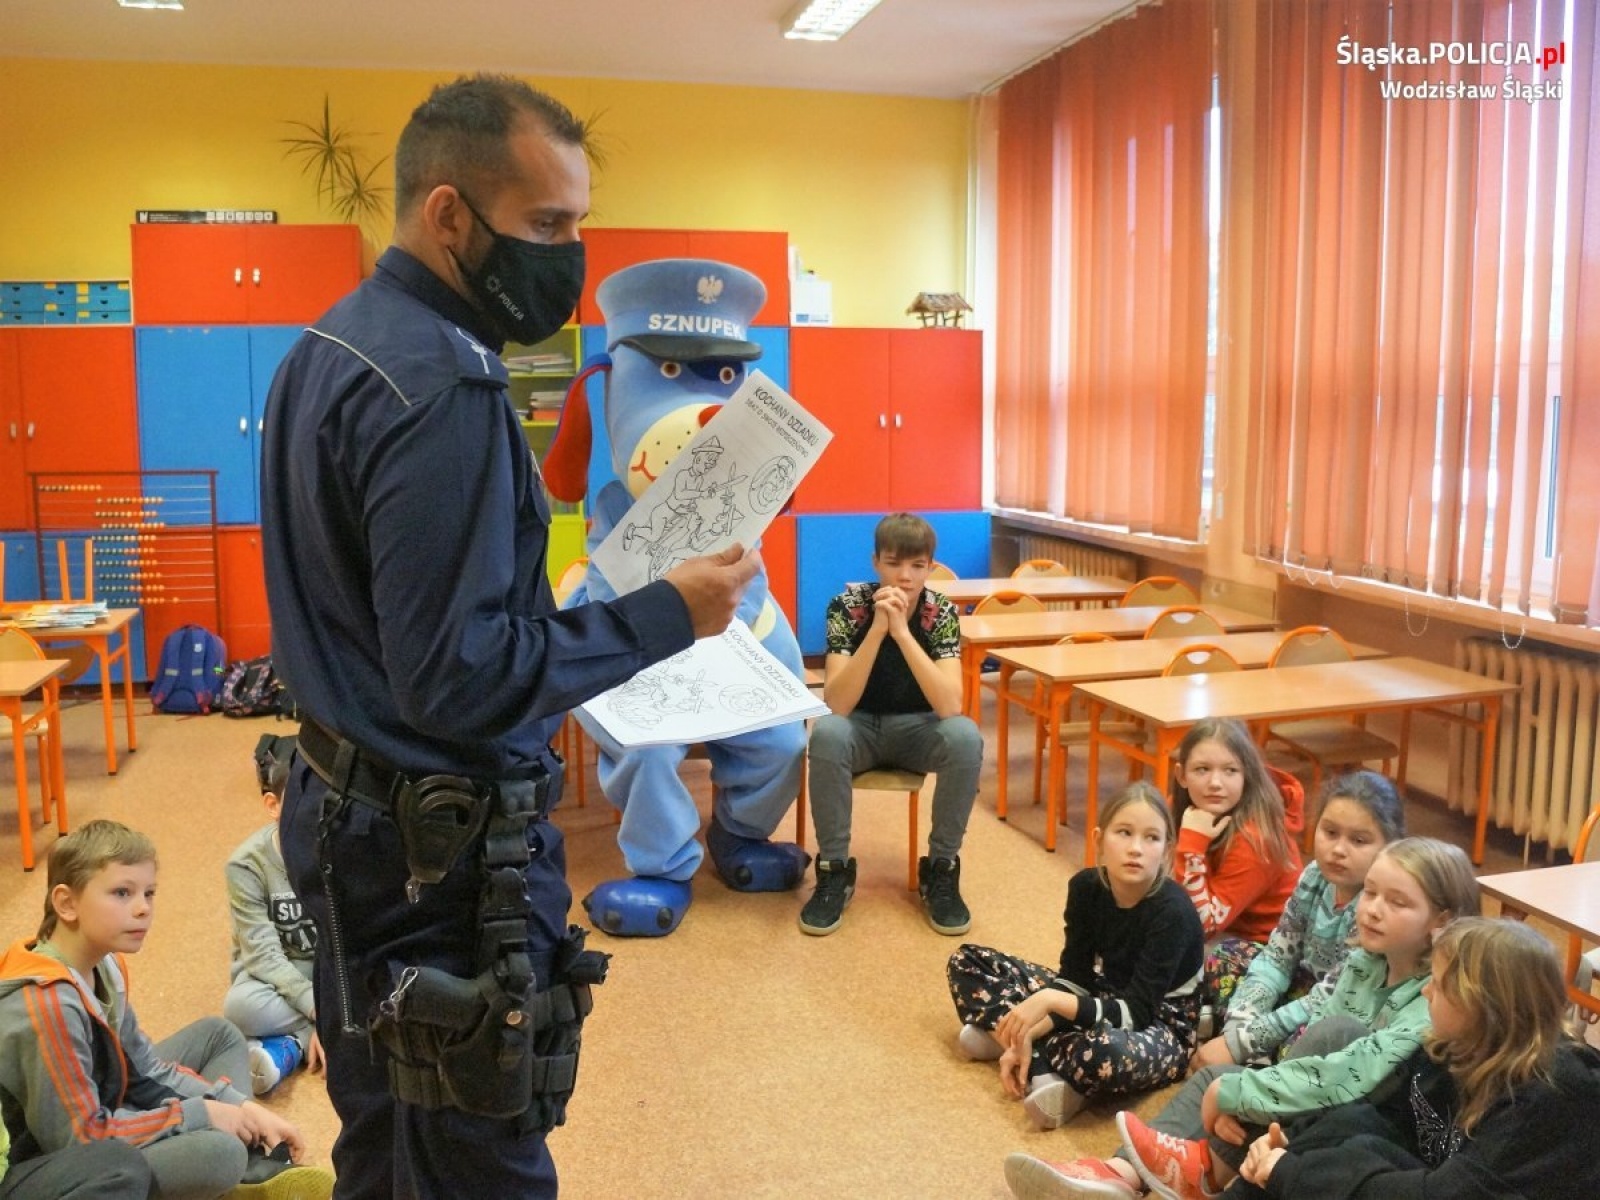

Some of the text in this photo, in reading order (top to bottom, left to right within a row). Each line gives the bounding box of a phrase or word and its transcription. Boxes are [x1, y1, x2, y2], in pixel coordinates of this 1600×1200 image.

[648, 313, 745, 341] SZNUPEK
[753, 386, 819, 447] KOCHANY DZIADKU
[728, 629, 767, 664] KOCHANY
